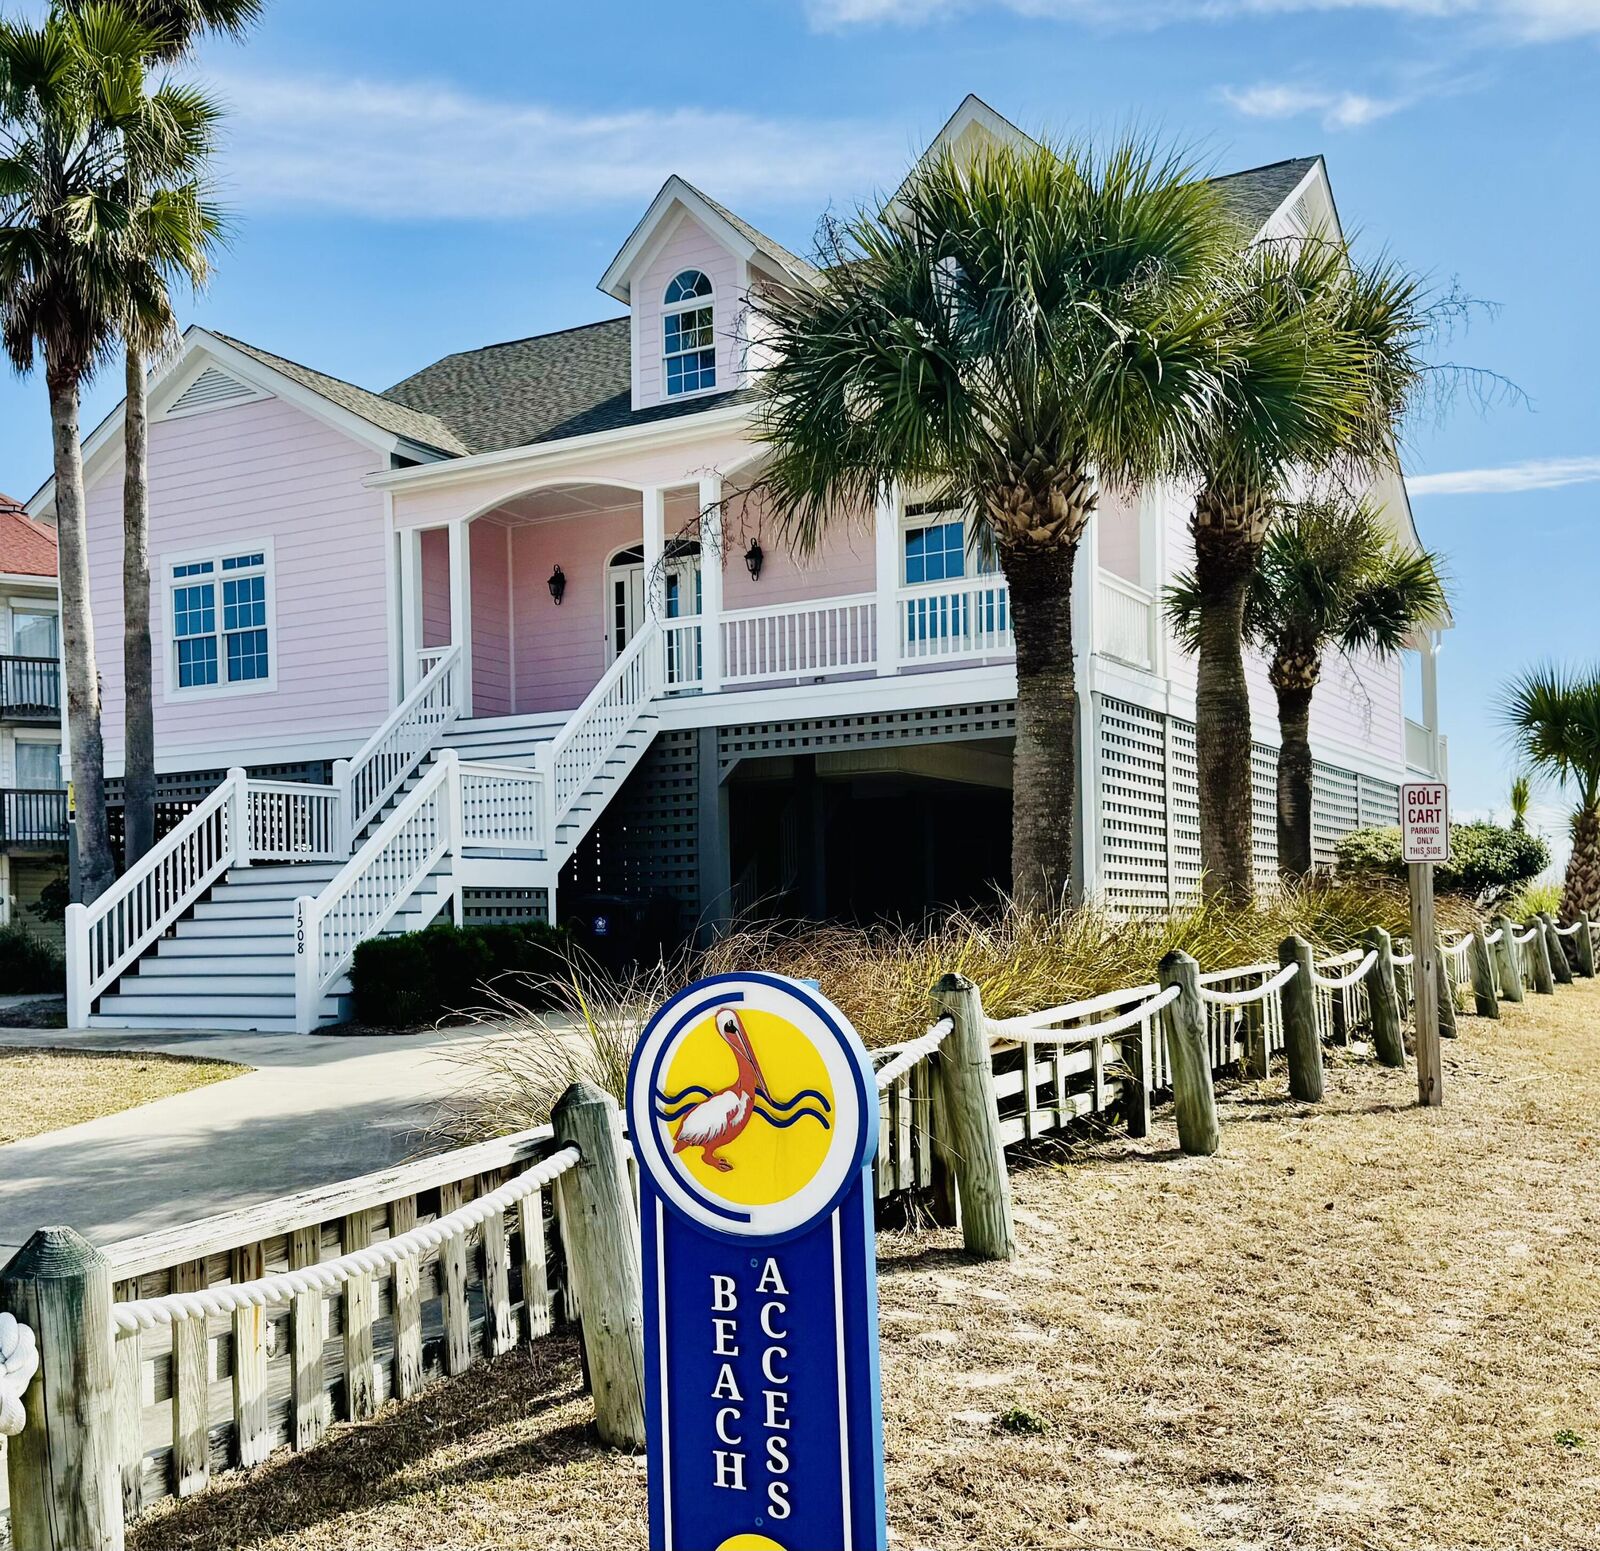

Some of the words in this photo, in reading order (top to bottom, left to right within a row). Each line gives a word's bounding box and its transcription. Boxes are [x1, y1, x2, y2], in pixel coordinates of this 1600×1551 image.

[1408, 791, 1441, 805] GOLF
[1408, 809, 1442, 823] CART
[710, 1275, 746, 1491] BEACH
[755, 1257, 791, 1520] ACCESS
